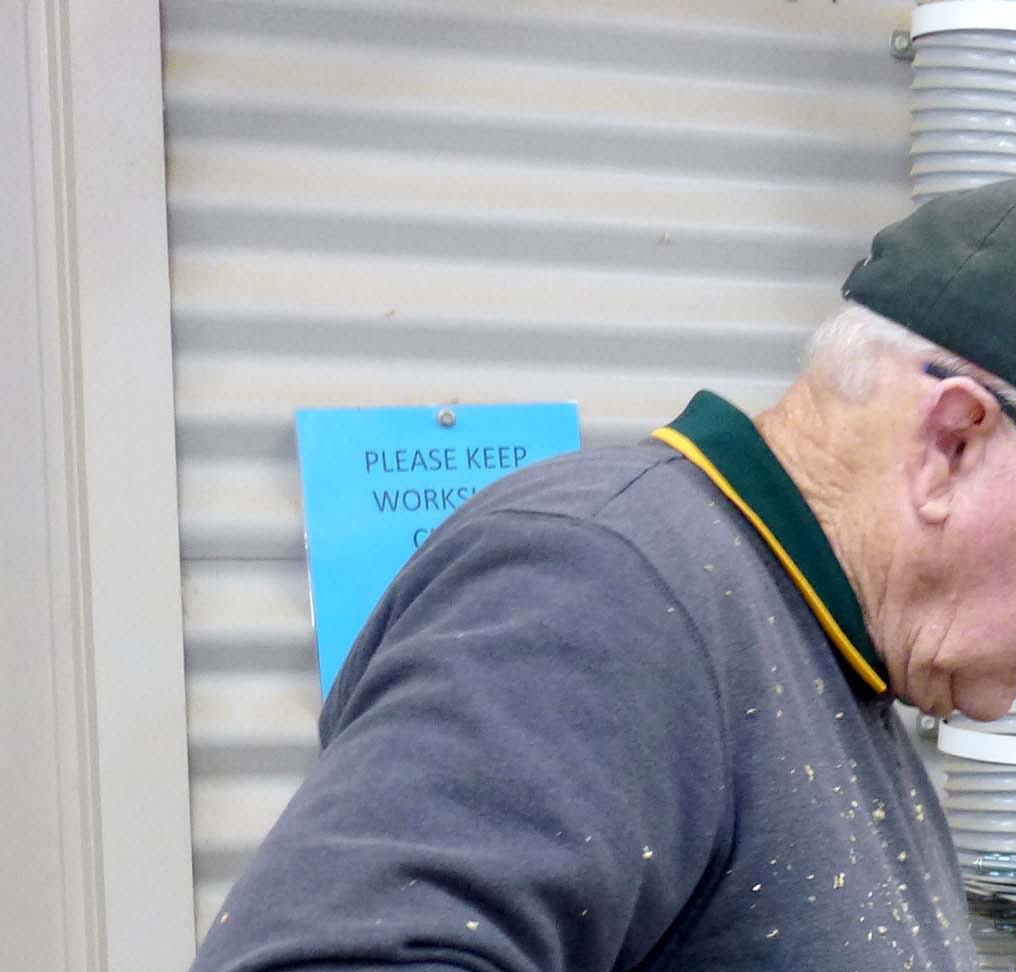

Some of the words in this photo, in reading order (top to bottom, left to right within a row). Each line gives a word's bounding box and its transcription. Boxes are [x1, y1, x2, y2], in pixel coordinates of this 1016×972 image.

[365, 449, 458, 473] PLEASE
[467, 446, 527, 470] KEEP
[373, 487, 476, 512] WORKS
